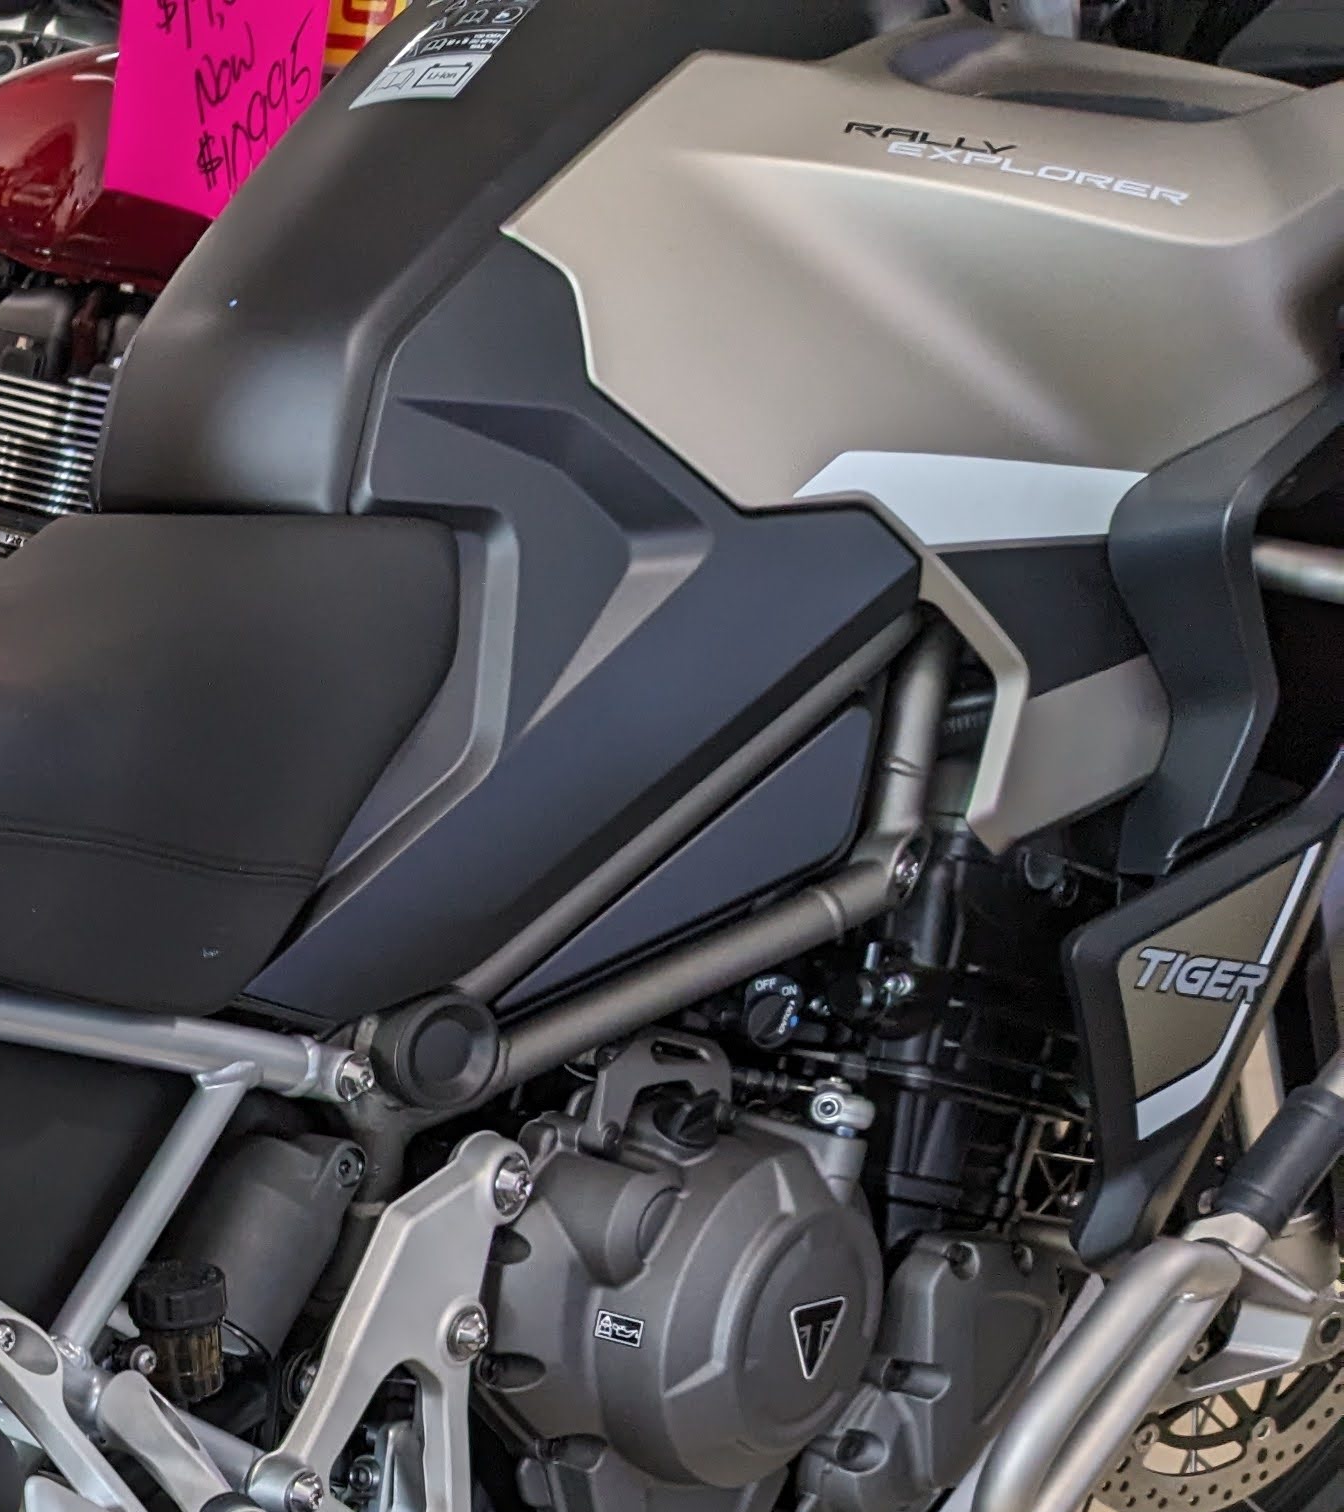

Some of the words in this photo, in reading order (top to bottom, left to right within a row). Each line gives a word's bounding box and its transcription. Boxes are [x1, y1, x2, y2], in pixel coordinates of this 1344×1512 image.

[843, 121, 1017, 155] RALLY
[887, 141, 1190, 206] EXPLORER
[755, 977, 778, 992] OFF
[781, 984, 798, 997] ON
[1134, 946, 1269, 1005] TIGER
